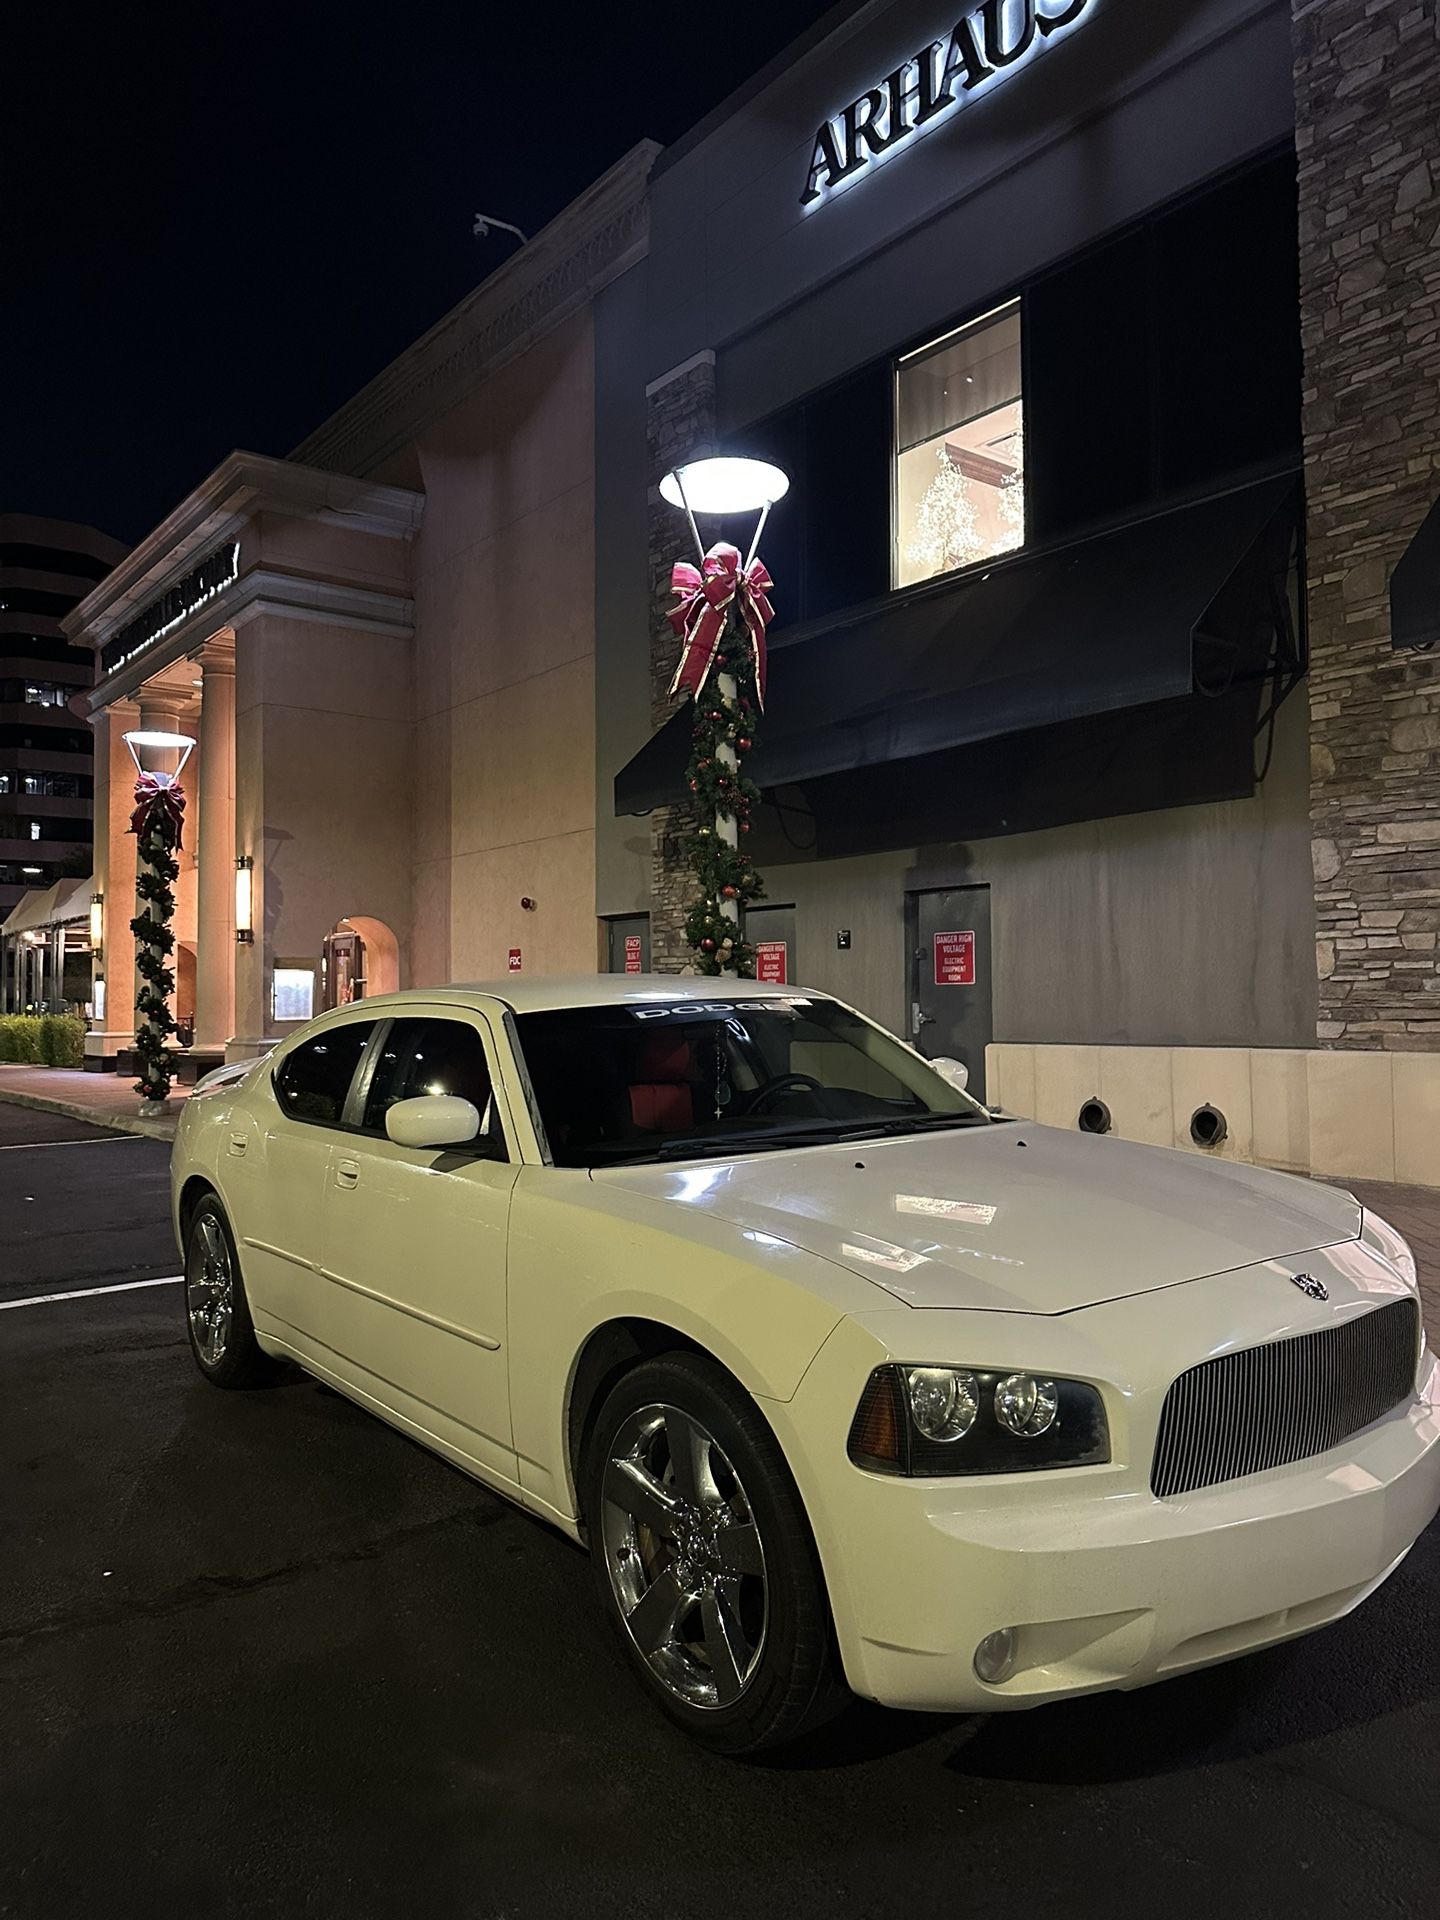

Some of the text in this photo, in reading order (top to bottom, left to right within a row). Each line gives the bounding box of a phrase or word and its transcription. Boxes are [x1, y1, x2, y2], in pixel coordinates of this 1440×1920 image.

[936, 934, 972, 944] DANGER HIGH
[943, 945, 965, 953] VOLTAGE
[510, 956, 521, 965] FDC
[944, 957, 964, 965] ELECTRIC
[635, 1003, 791, 1019] DODGE
